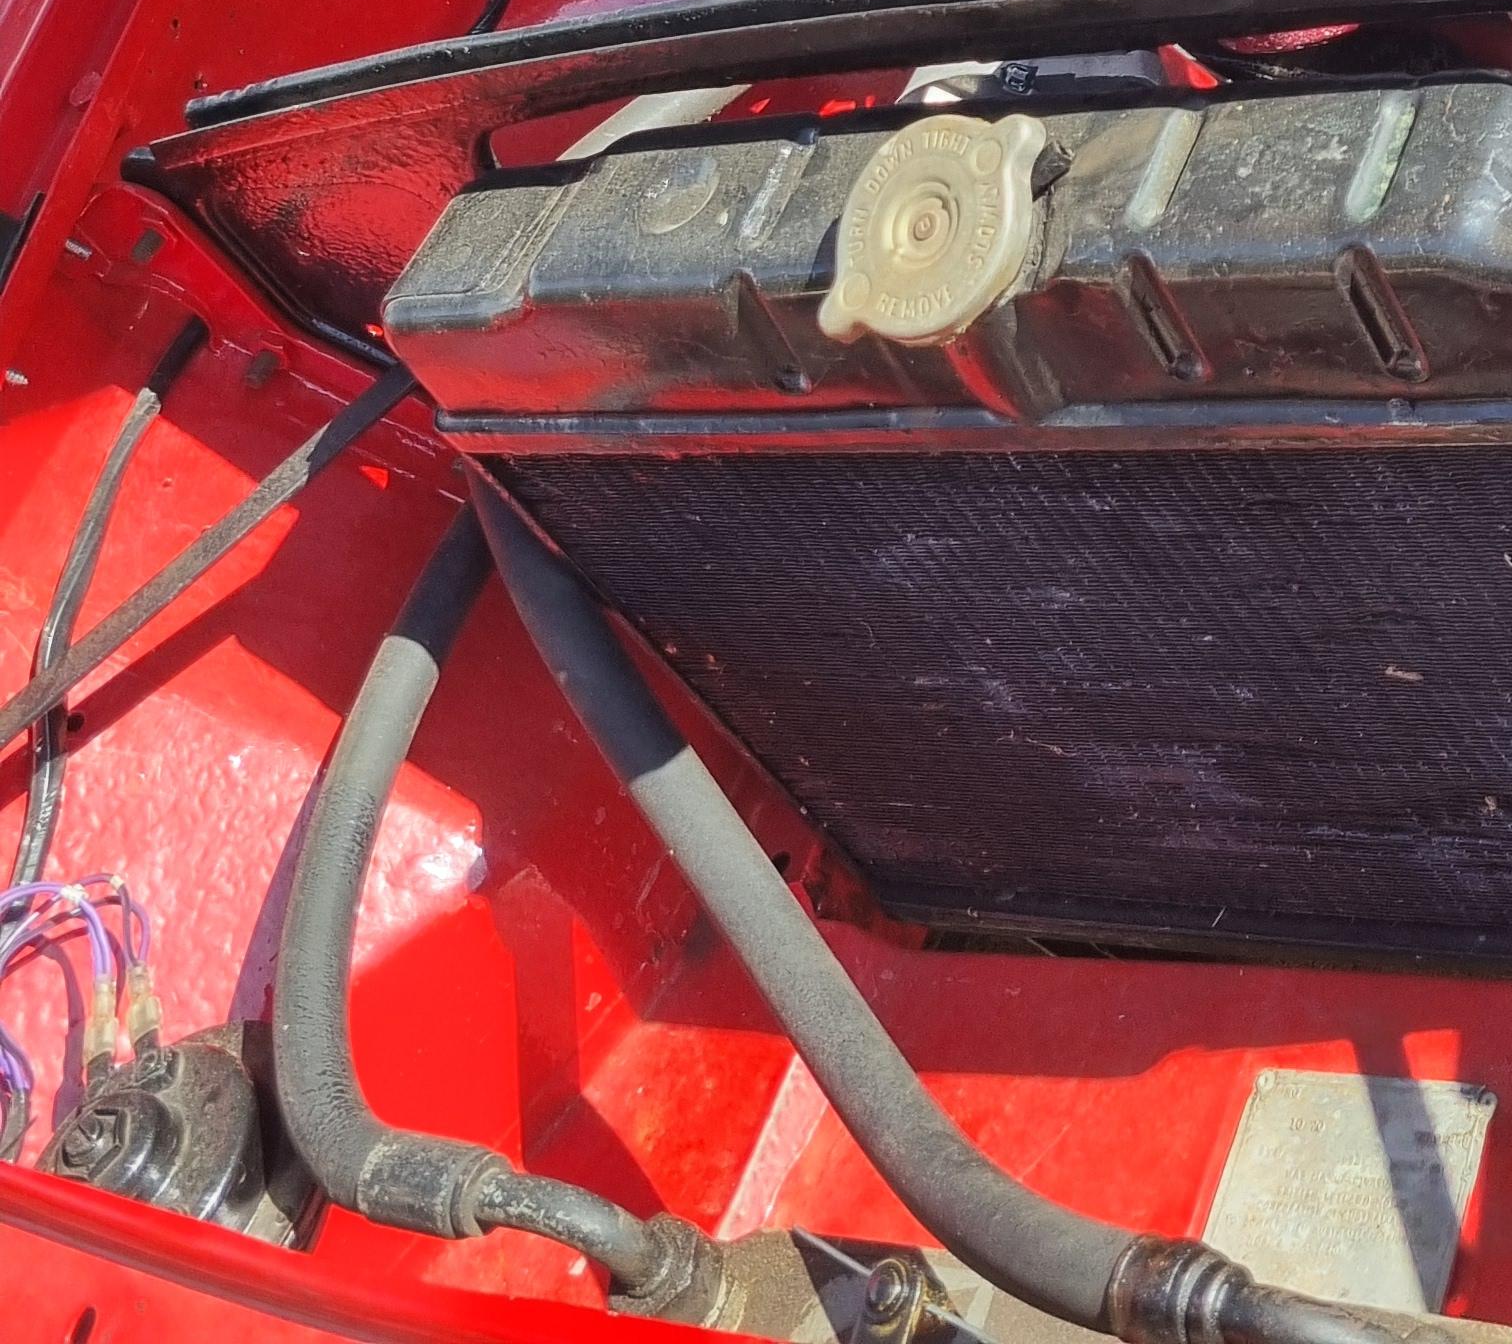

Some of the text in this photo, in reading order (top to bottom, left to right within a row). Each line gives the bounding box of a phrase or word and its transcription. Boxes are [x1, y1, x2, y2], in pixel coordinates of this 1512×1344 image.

[847, 128, 971, 268] TURN DOWN TIGHT
[875, 283, 953, 318] REMOVE
